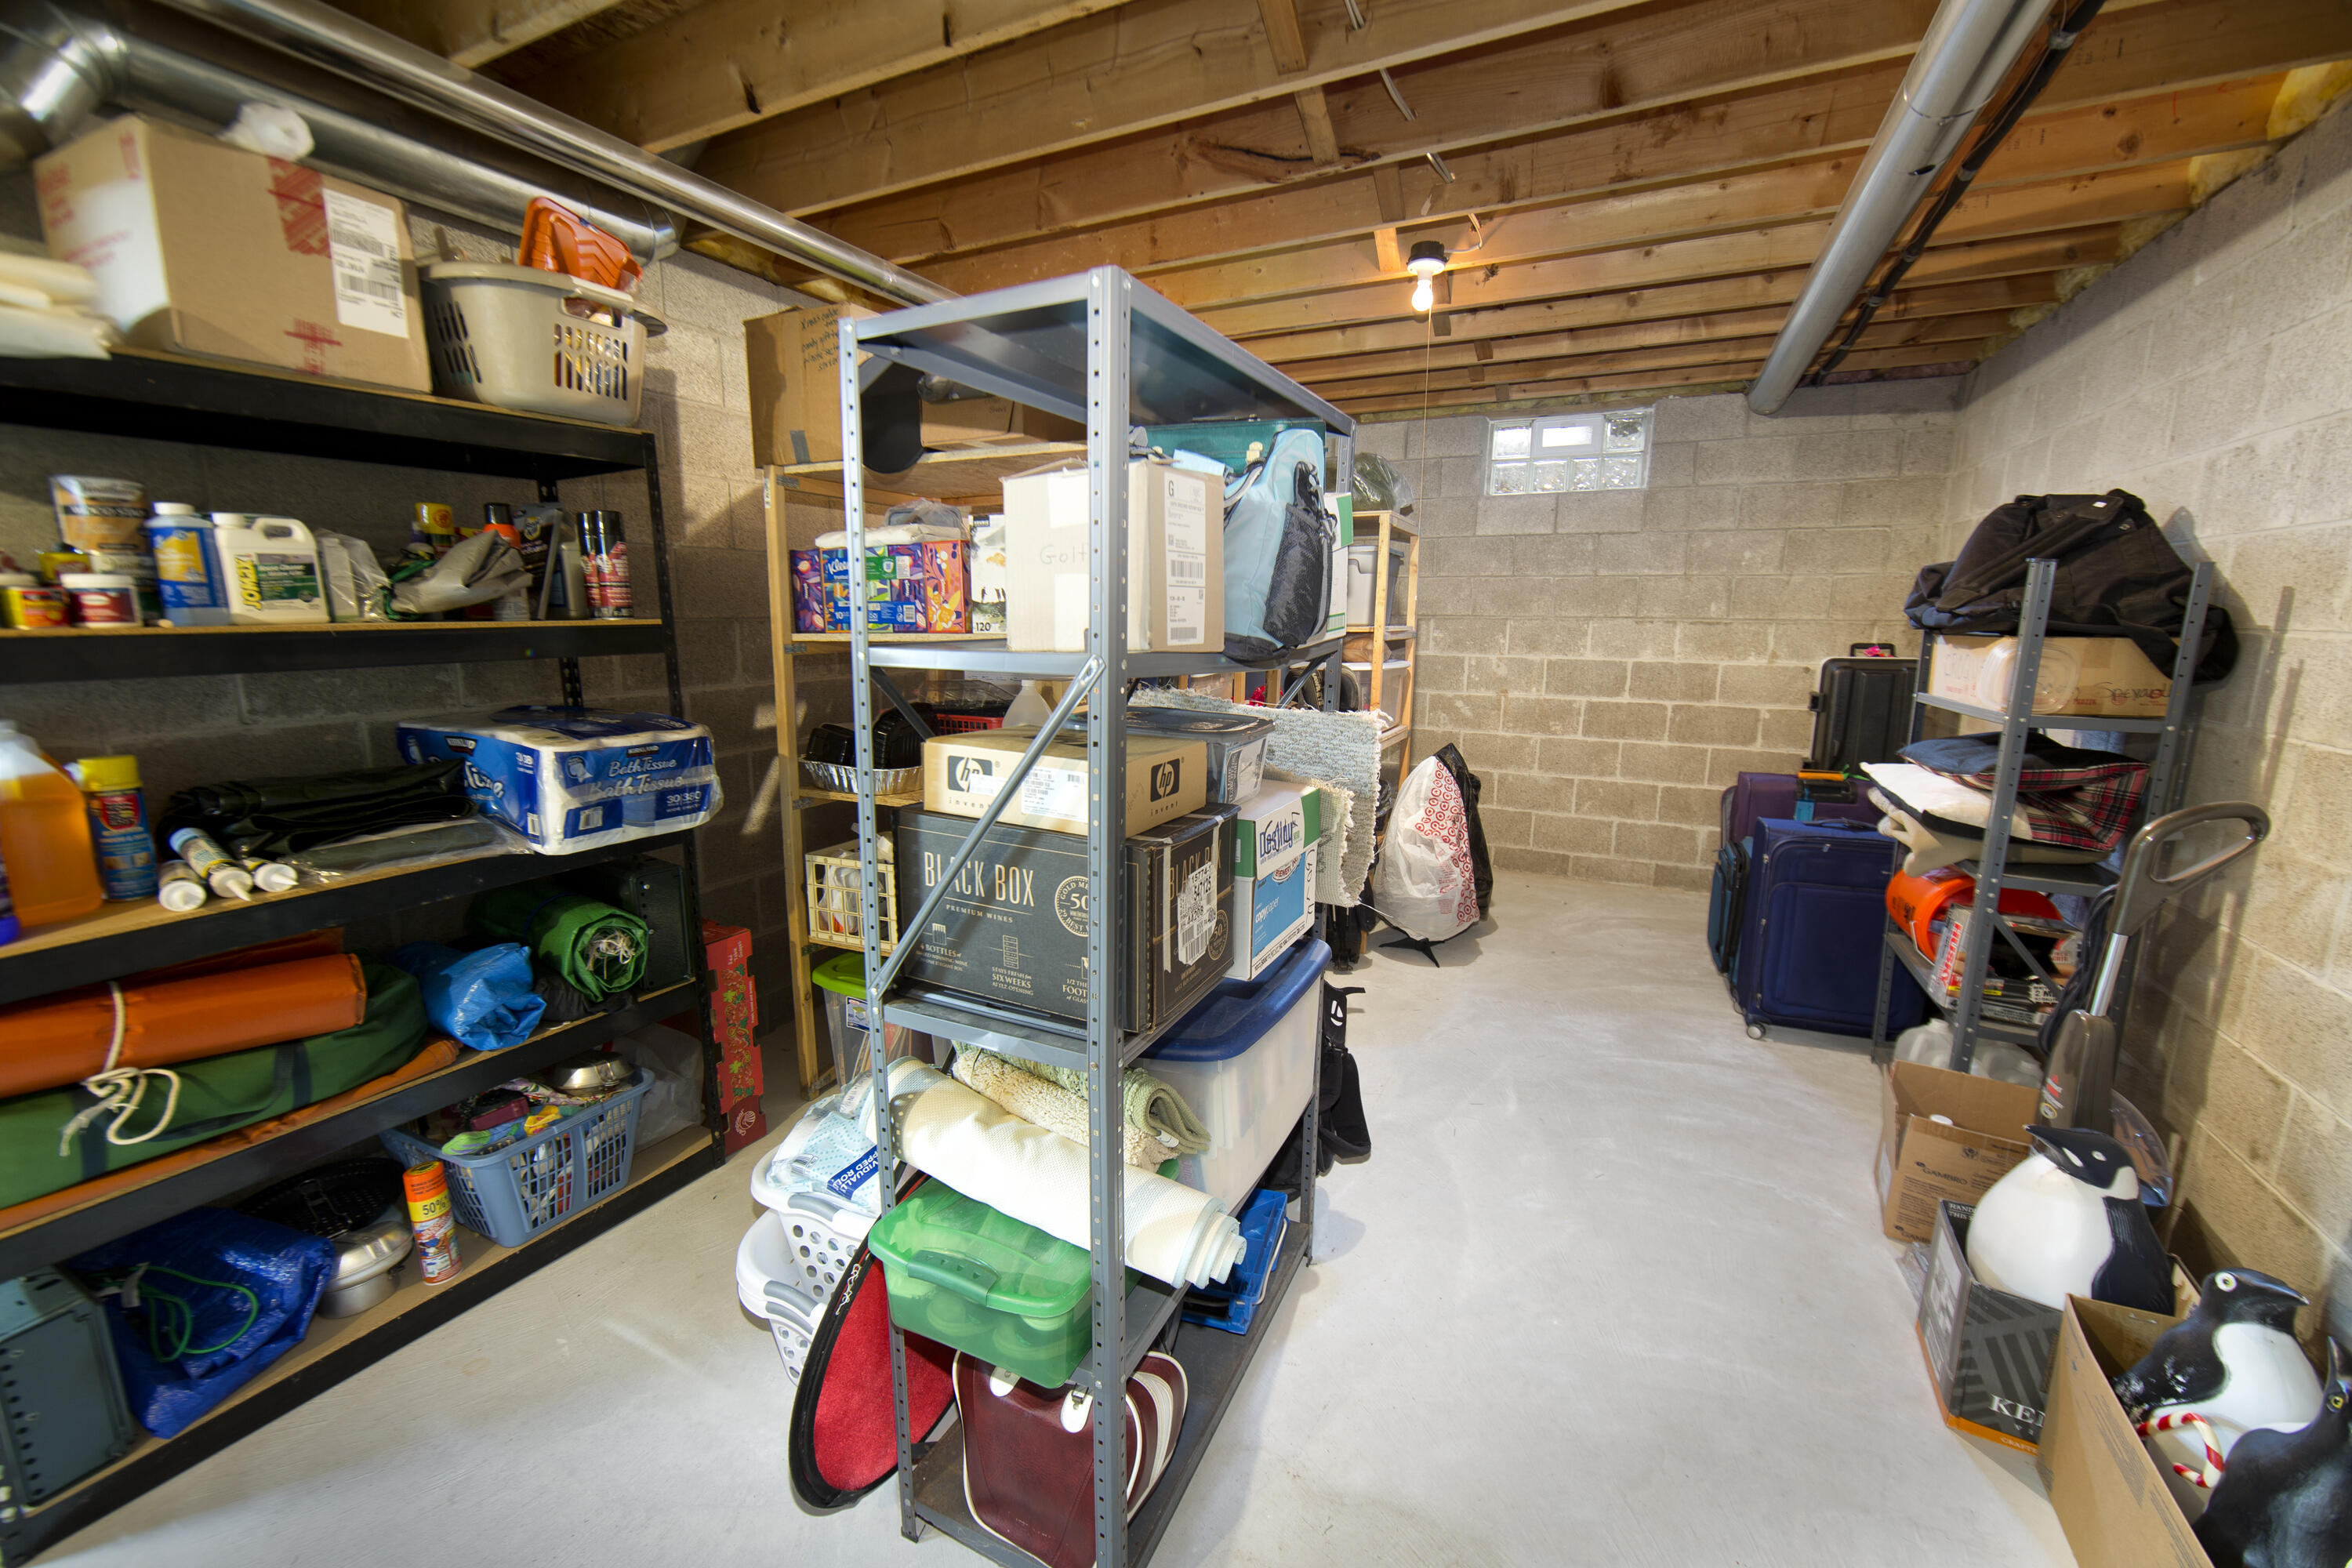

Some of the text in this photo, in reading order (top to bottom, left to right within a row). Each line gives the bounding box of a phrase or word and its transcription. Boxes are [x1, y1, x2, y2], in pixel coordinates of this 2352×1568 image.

[1168, 480, 1174, 497] G
[975, 622, 991, 632] 120
[608, 756, 677, 778] Bath Tissue
[636, 774, 684, 796] Tissue
[667, 794, 681, 804] 30
[1150, 801, 1178, 816] invent
[1259, 821, 1294, 858] Destiny
[995, 864, 1035, 907] BOX
[1060, 882, 1076, 900] GOLD
[946, 904, 1014, 924] PREMIUM WINES
[925, 944, 956, 957] BOTTLES
[1937, 921, 1964, 988] HUSKY
[992, 972, 1032, 989] SIX WEEKS
[1062, 984, 1089, 998] FOOT
[1922, 1168, 1969, 1186] GAMBRO
[422, 1198, 447, 1216] 50%
[1949, 1203, 1976, 1214] HAND
